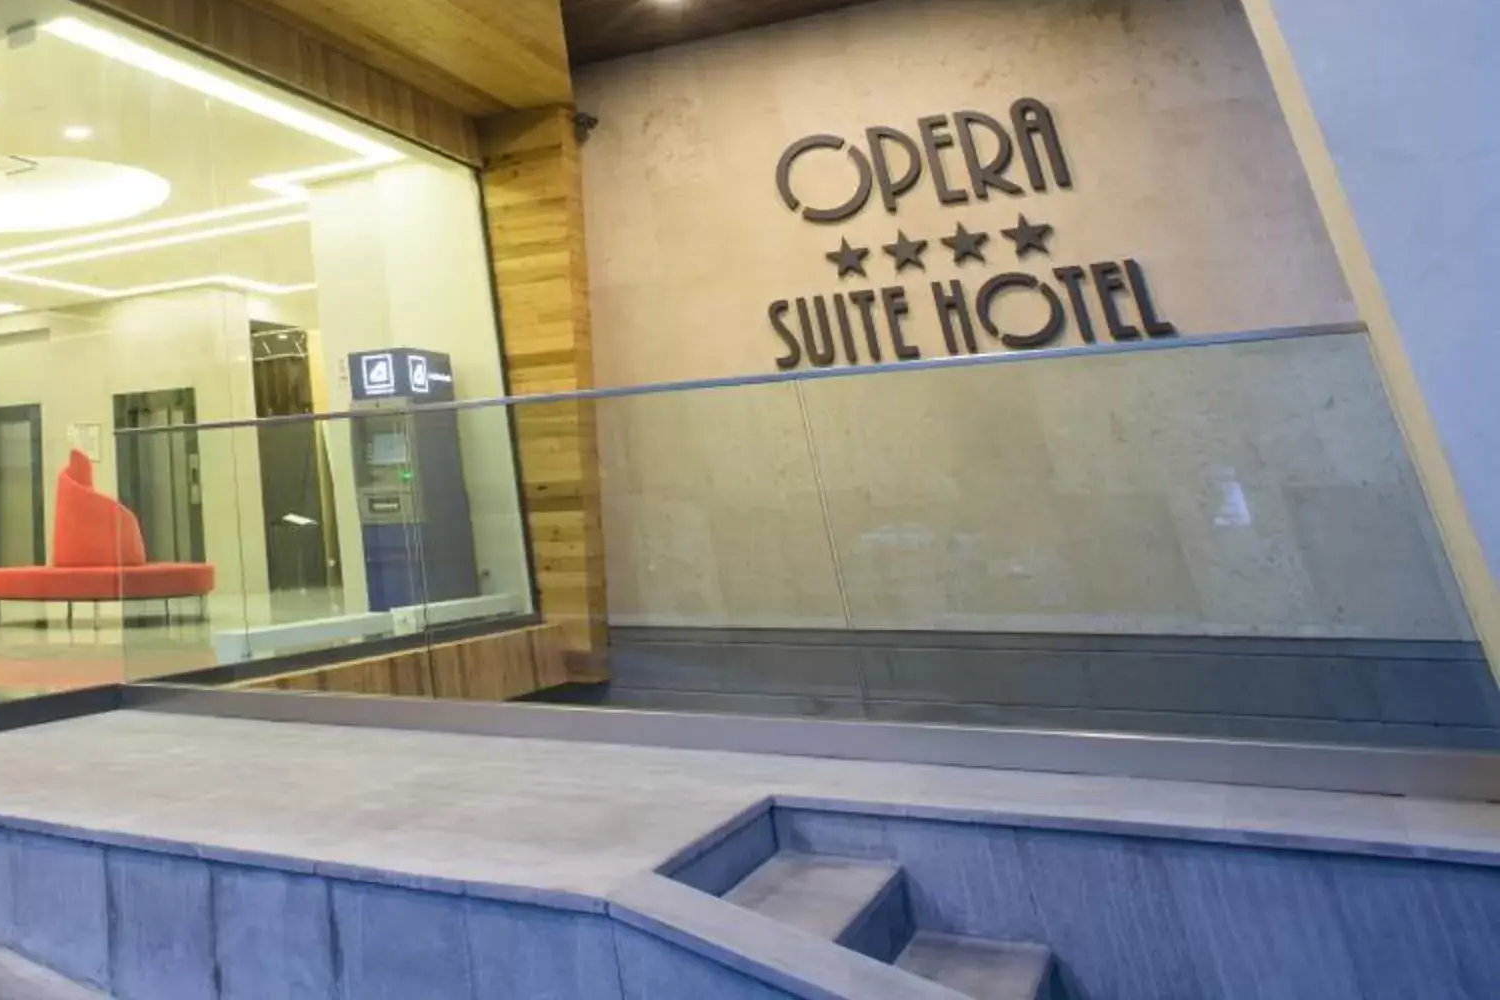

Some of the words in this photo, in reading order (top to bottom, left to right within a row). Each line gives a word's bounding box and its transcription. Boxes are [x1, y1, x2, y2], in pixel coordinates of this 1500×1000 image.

[775, 97, 1073, 222] OPERA
[767, 285, 921, 369] SUITE
[931, 258, 1177, 354] HOTEL
